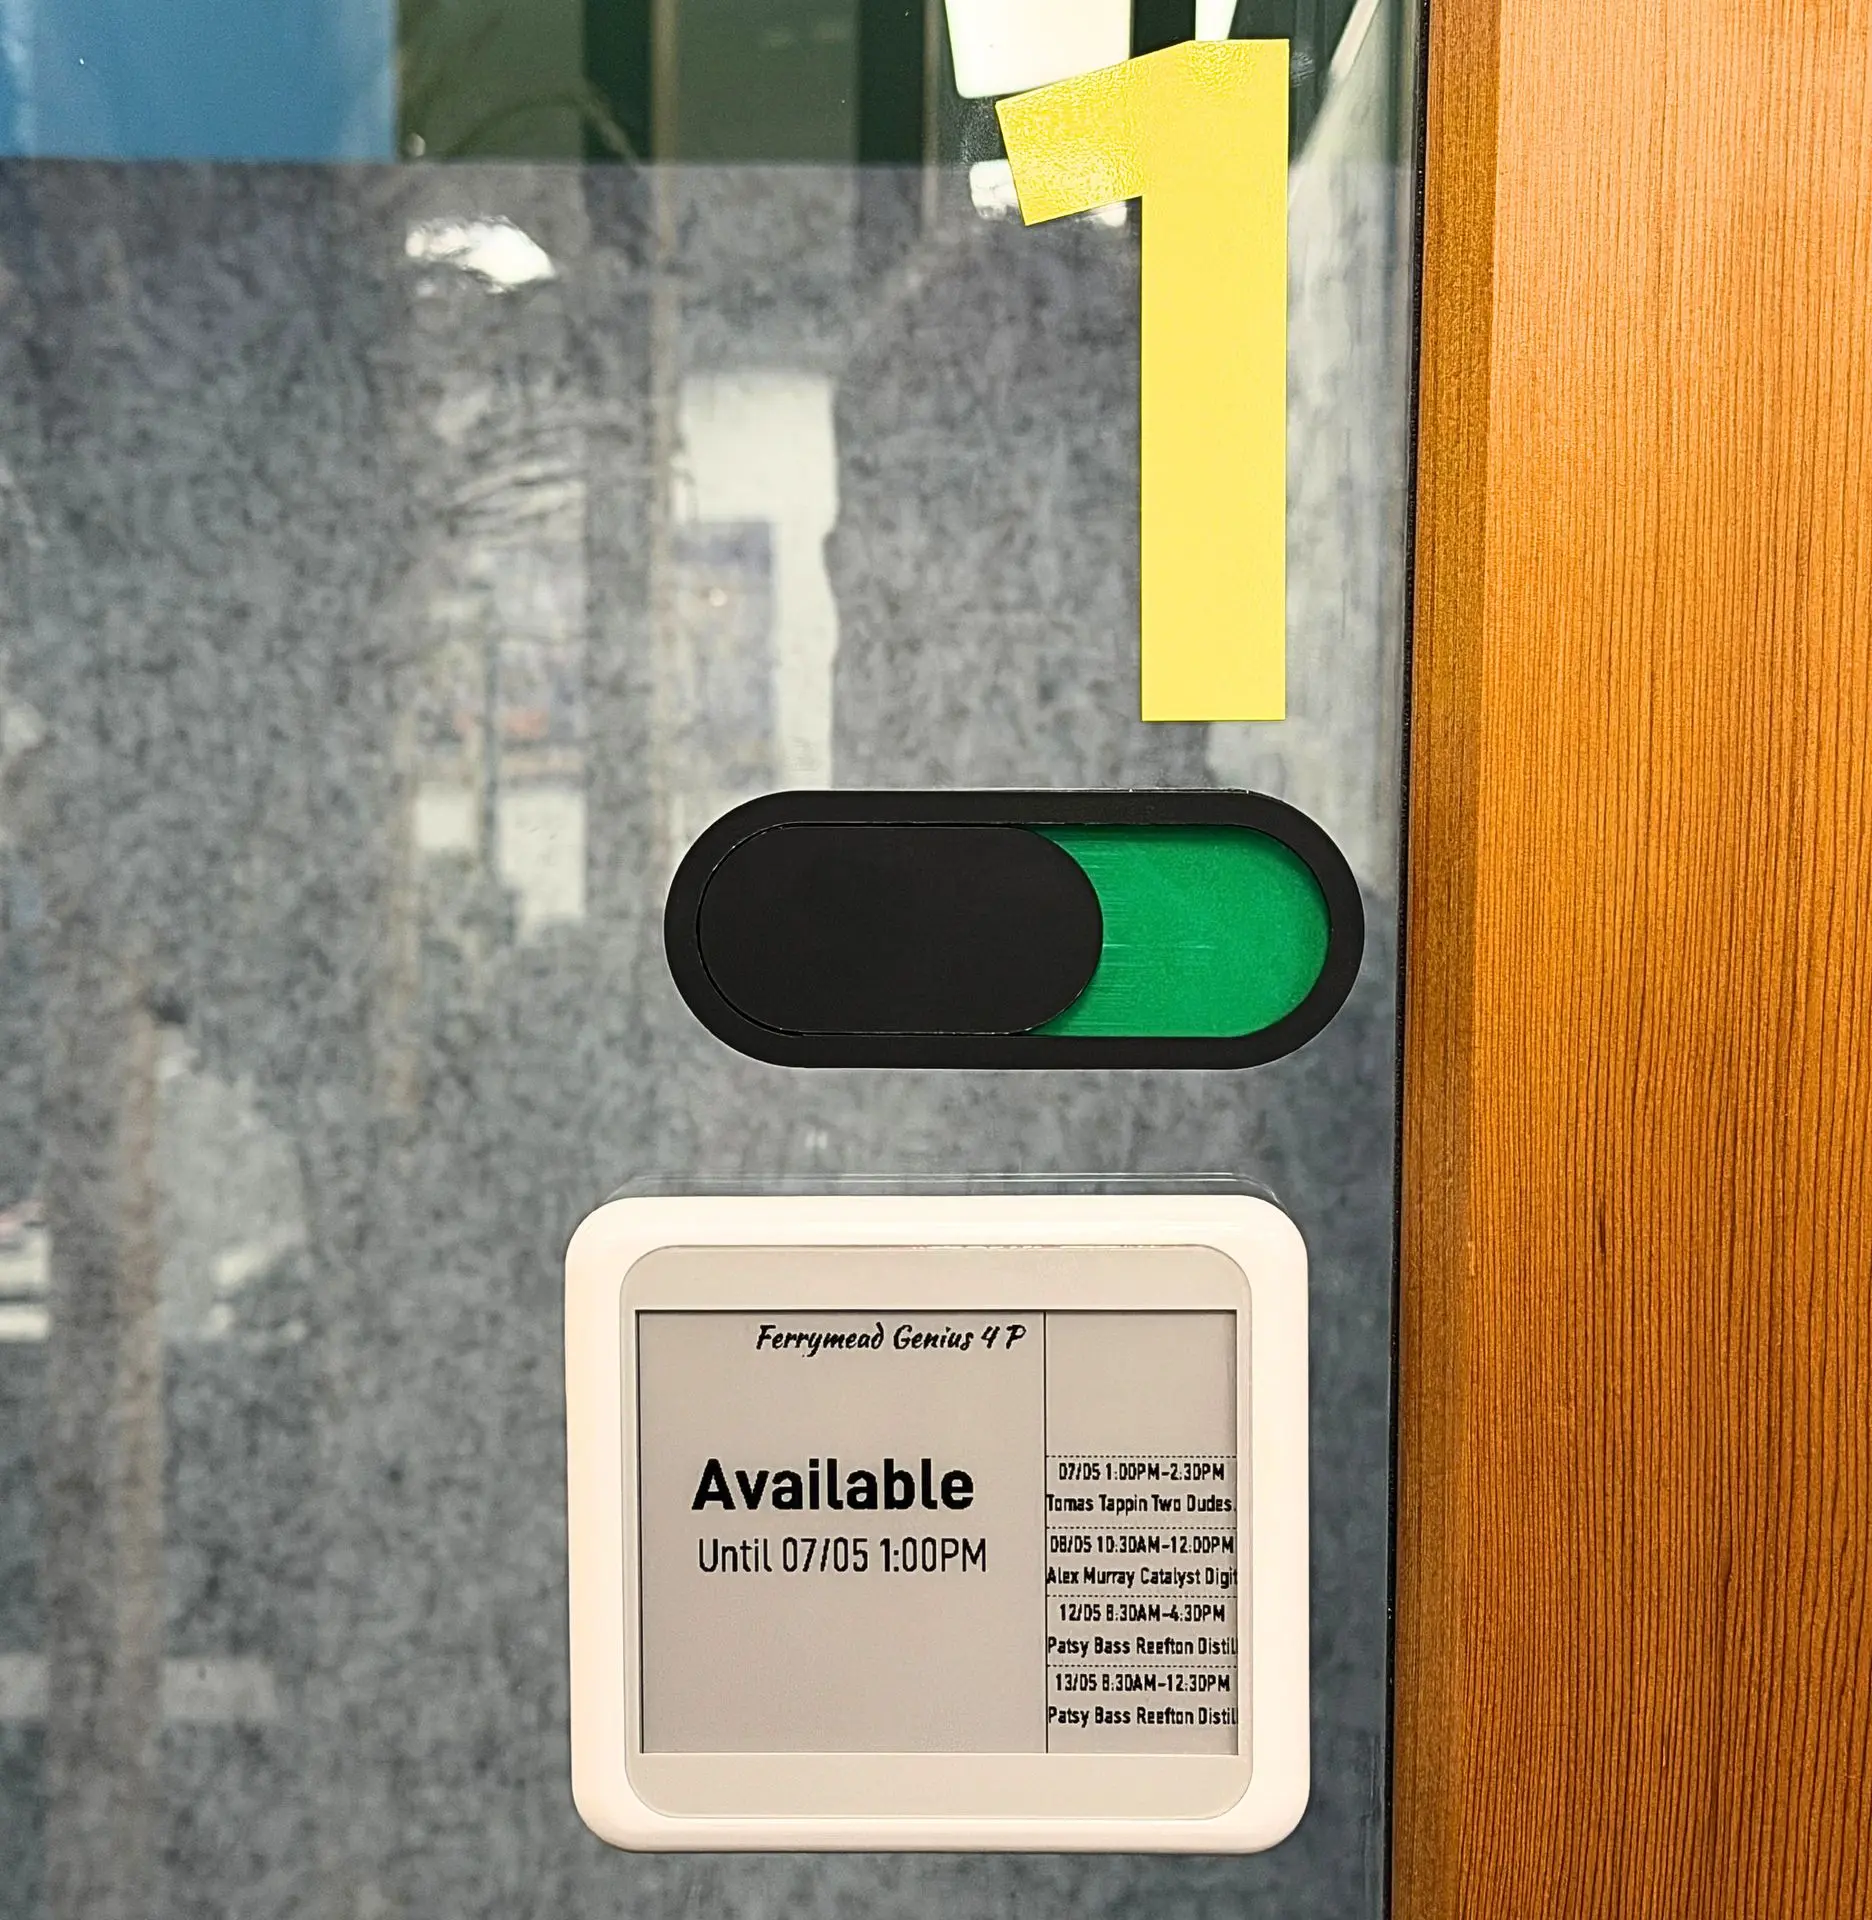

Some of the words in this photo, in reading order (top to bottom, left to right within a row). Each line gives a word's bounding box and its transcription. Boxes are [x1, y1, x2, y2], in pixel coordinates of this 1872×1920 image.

[995, 38, 1289, 723] 1
[756, 1321, 884, 1358] Ferrymead
[893, 1324, 974, 1351] Genius
[981, 1326, 1000, 1349] 4
[1005, 1324, 1027, 1349] P
[1058, 1462, 1101, 1481] 07/05
[691, 1458, 974, 1510] Available
[1045, 1493, 1094, 1512] Tomas
[1098, 1493, 1148, 1516] Tappin
[1151, 1494, 1182, 1512] Two
[699, 1538, 773, 1573] Until
[782, 1537, 869, 1573] 07/05
[879, 1537, 987, 1573] 1:00PM
[1050, 1535, 1093, 1554] 08/05
[1046, 1566, 1079, 1585] Alex
[1083, 1566, 1135, 1589] Murray
[1140, 1567, 1201, 1589] Catalyst
[1059, 1604, 1102, 1622] 12/05
[1047, 1636, 1090, 1659] Patsy
[1094, 1636, 1131, 1655] Bass
[1136, 1636, 1194, 1656] Reefton
[1055, 1673, 1098, 1692] 13/05
[1048, 1706, 1090, 1729] Patsy
[1094, 1706, 1132, 1725] Bass
[1136, 1706, 1194, 1726] Reefton
